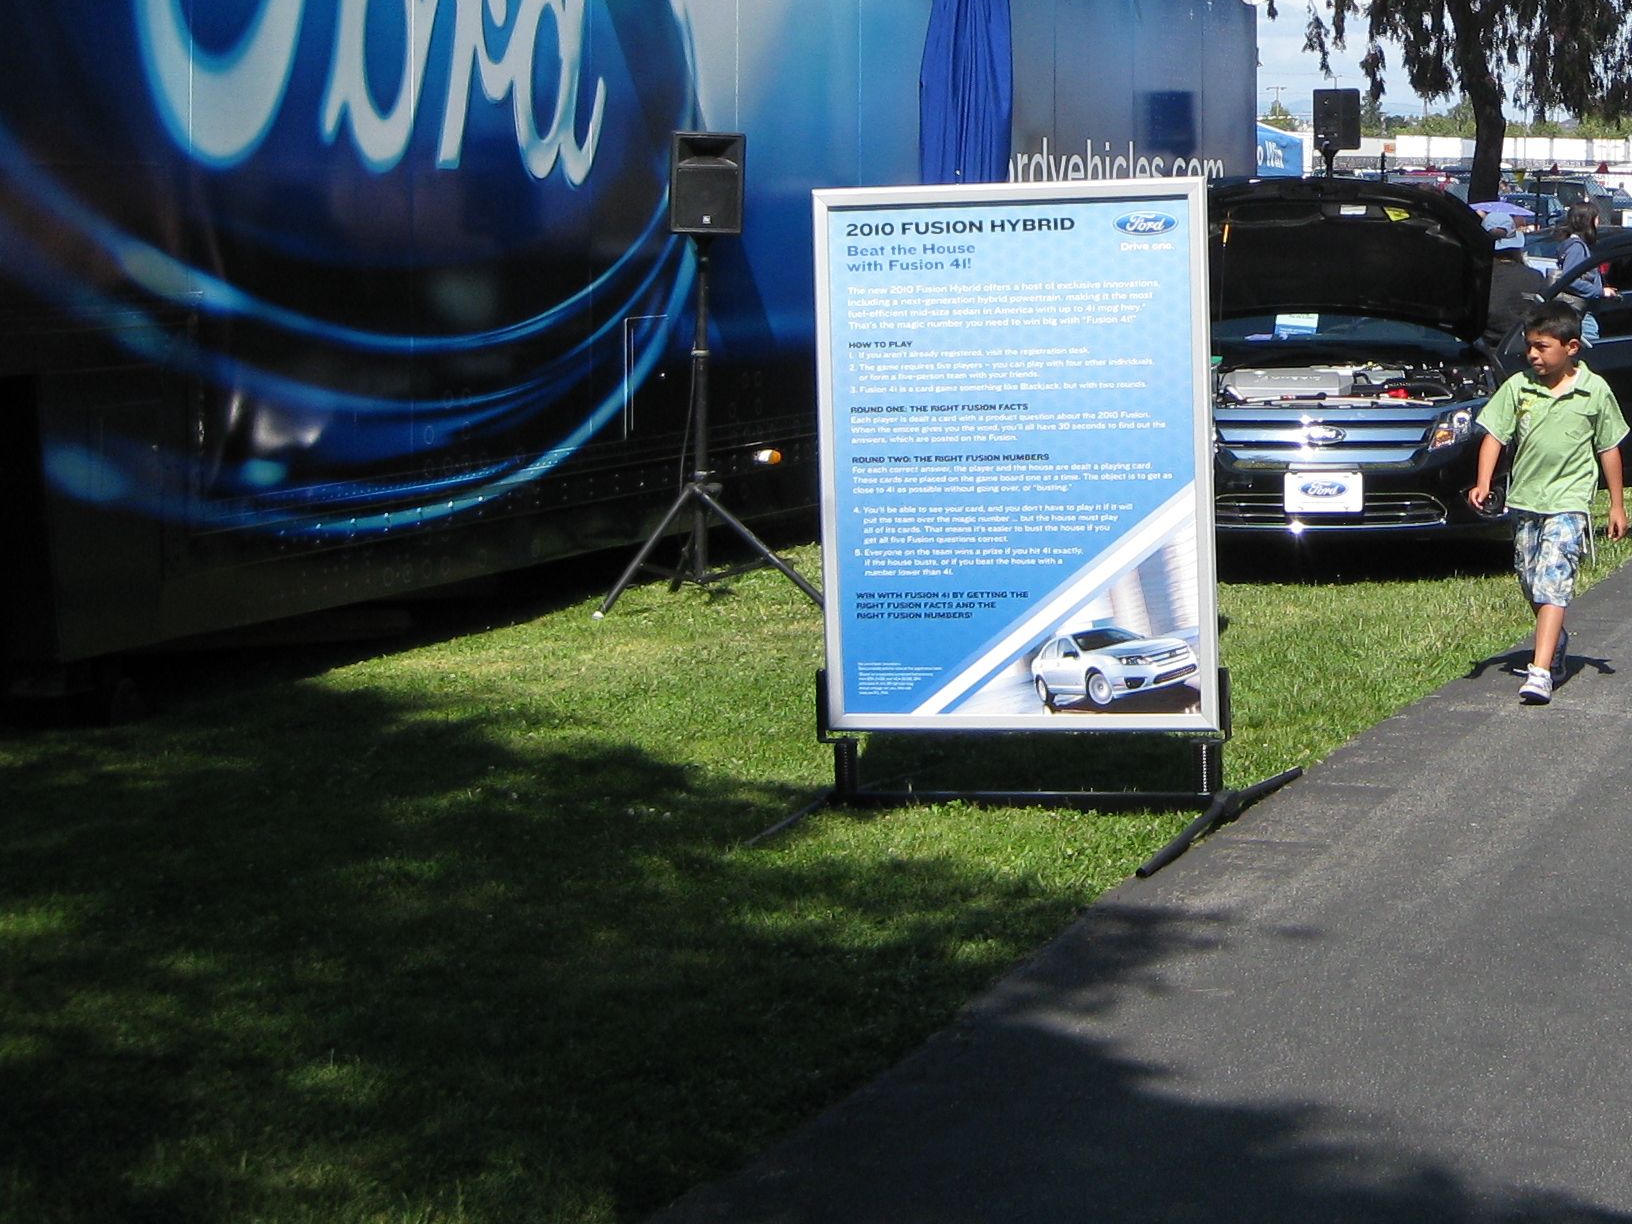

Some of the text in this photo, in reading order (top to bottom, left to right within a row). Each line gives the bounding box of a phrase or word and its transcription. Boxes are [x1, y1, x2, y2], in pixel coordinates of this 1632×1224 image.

[1008, 137, 1224, 183] rdvehiclescom
[846, 218, 1076, 236] 2010 FUSION HYBRID
[847, 243, 977, 256] Beat the House
[1120, 242, 1176, 250] Drive one.
[847, 258, 973, 272] with Fusion 41!
[848, 286, 866, 294] The
[890, 285, 914, 293] 2010
[916, 285, 947, 293] Fusion
[949, 284, 981, 294] Hybrid
[983, 283, 1011, 291] offers
[1021, 283, 1043, 291] host
[1056, 282, 1101, 290] exclusive
[904, 591, 939, 599] FUSION
[941, 591, 950, 599] 41
